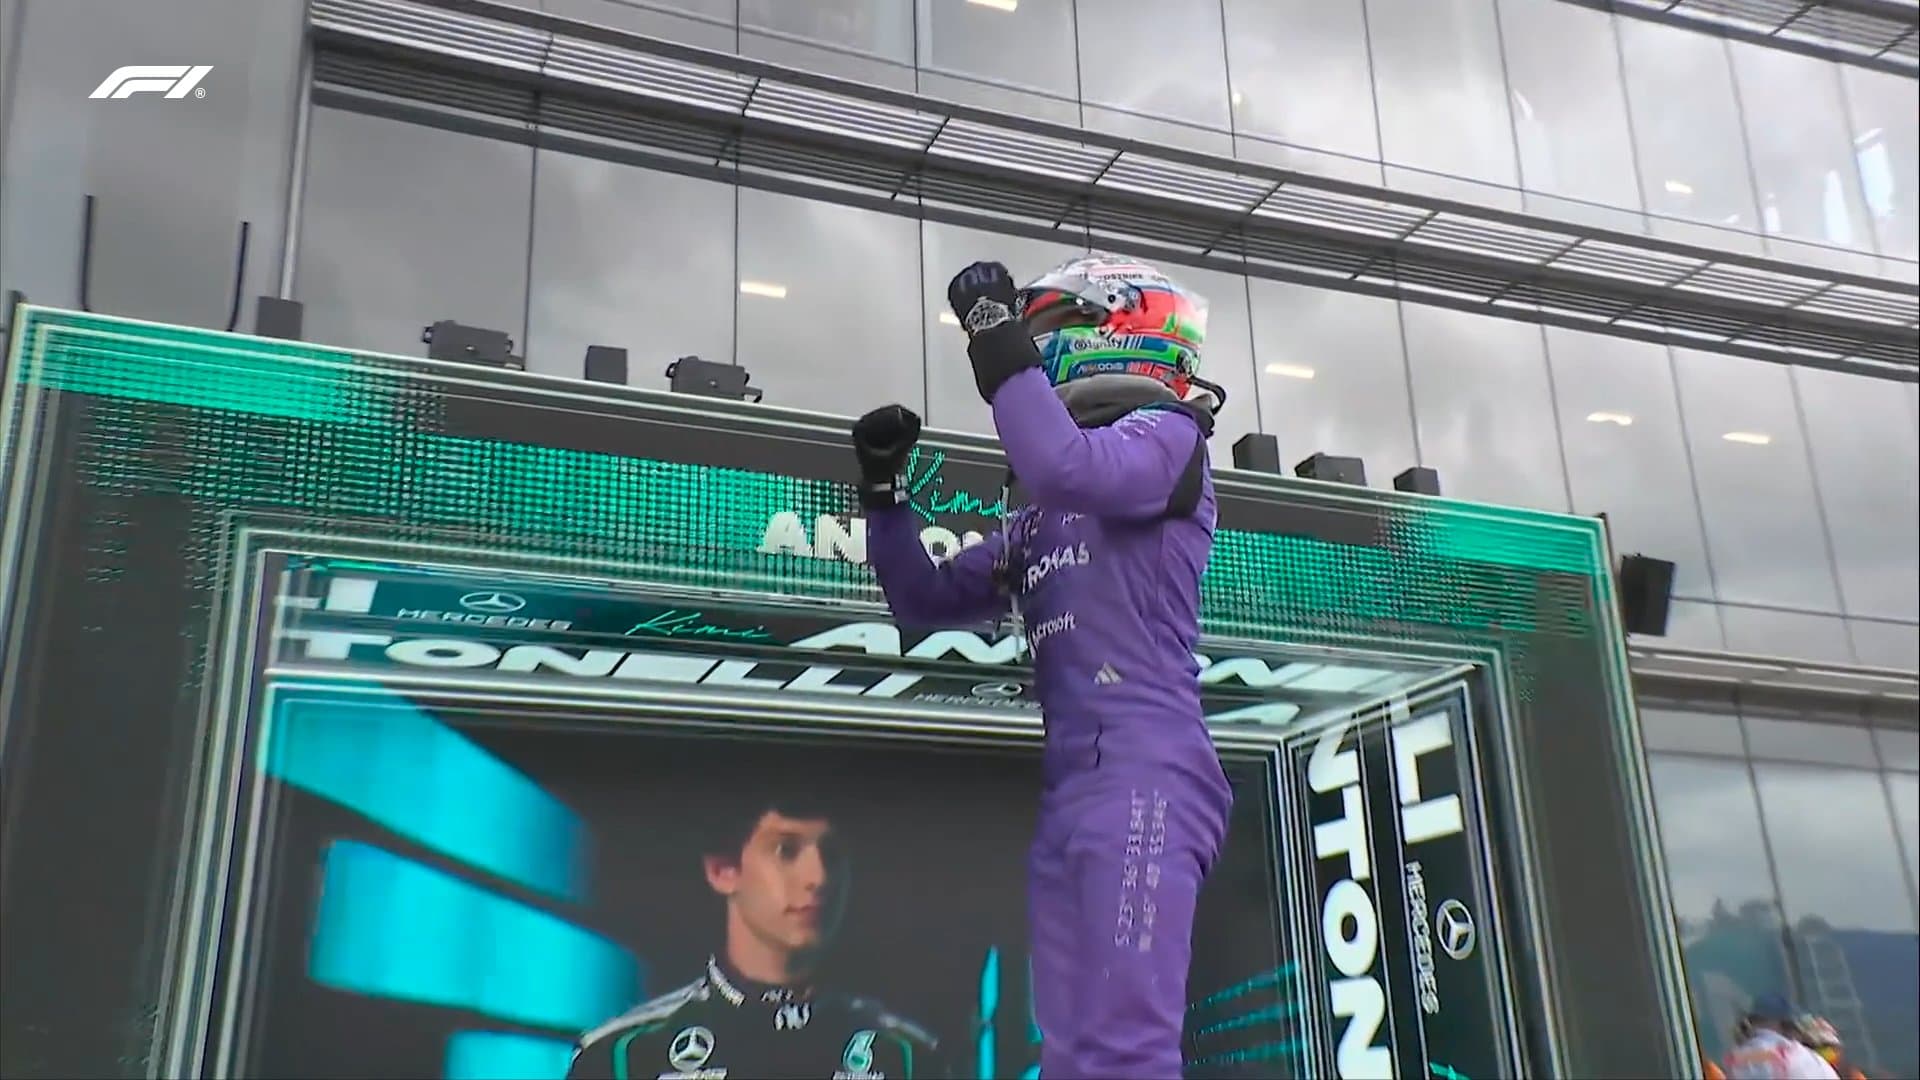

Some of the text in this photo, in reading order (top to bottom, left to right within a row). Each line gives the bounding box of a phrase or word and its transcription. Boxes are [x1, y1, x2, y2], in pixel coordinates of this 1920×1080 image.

[624, 609, 773, 639] Kimi
[283, 630, 924, 698] TONELLI
[1406, 861, 1440, 1014] MERCEDES
